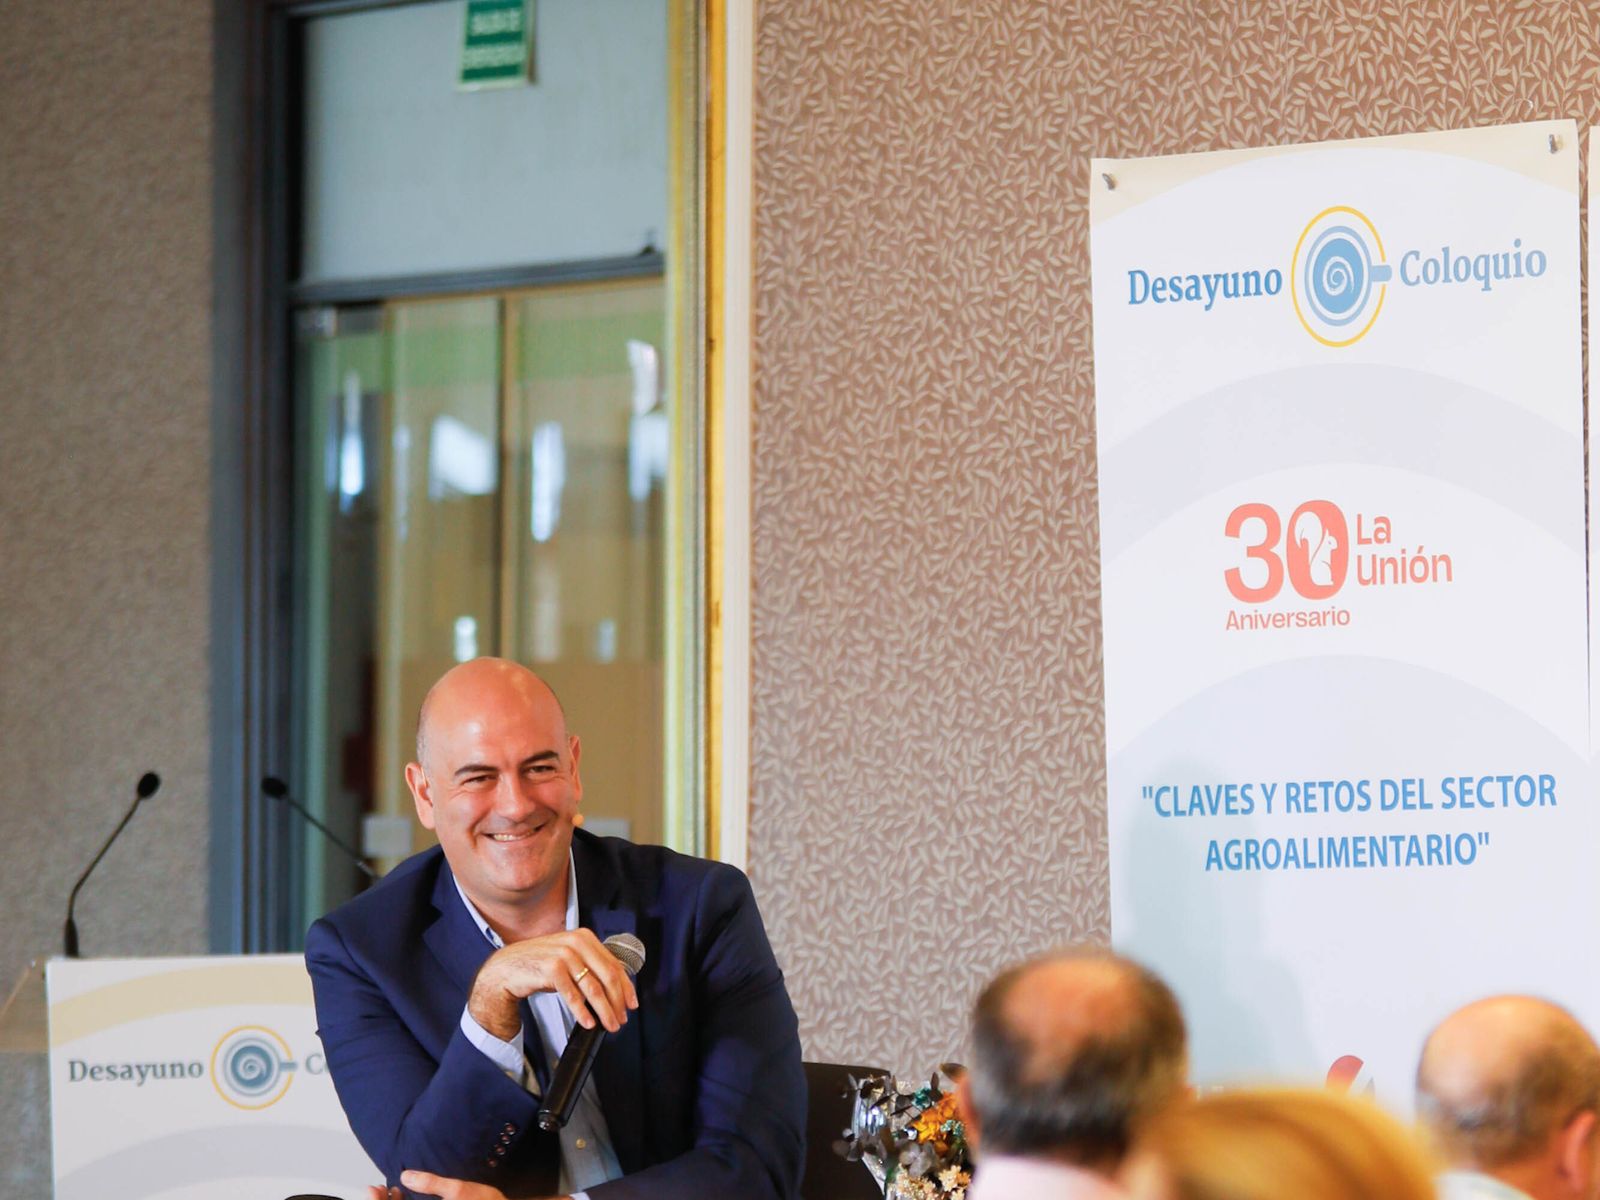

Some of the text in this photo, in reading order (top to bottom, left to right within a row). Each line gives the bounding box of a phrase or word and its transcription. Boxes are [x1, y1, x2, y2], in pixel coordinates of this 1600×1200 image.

[1128, 238, 1547, 311] Desayuno Coloquio
[1356, 513, 1392, 545] La
[1224, 500, 1350, 604] 30
[1225, 607, 1352, 632] Aniversario
[1141, 773, 1558, 818] "CLAVES Y RETOS DEL SECTOR
[1204, 831, 1491, 872] AGROALIMENTARIO"
[67, 1060, 204, 1086] Desayuno
